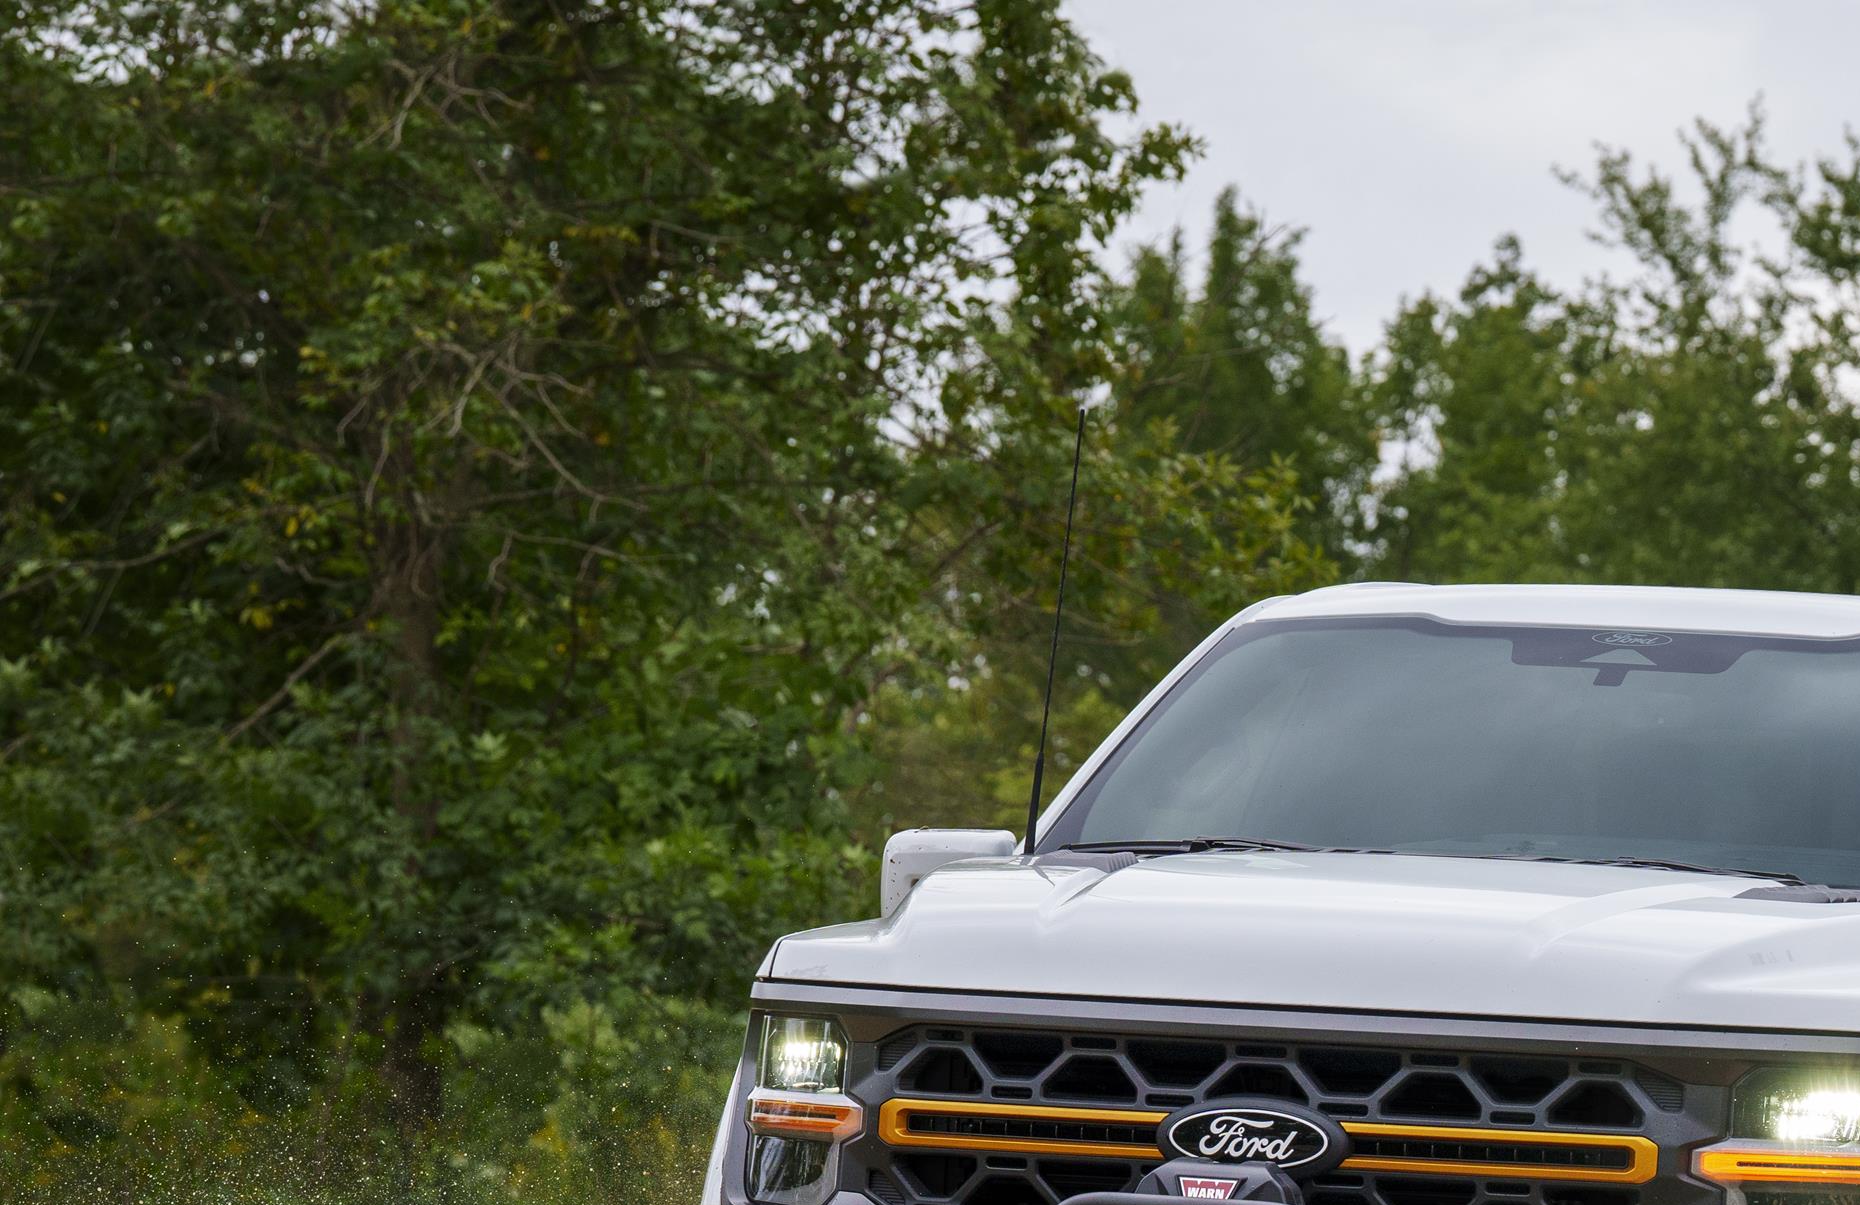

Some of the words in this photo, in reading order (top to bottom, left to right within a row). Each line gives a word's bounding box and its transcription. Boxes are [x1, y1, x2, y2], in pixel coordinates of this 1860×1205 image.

[1605, 633, 1658, 644] Ford
[1199, 1116, 1298, 1160] Ford
[1187, 1187, 1224, 1200] WARN
